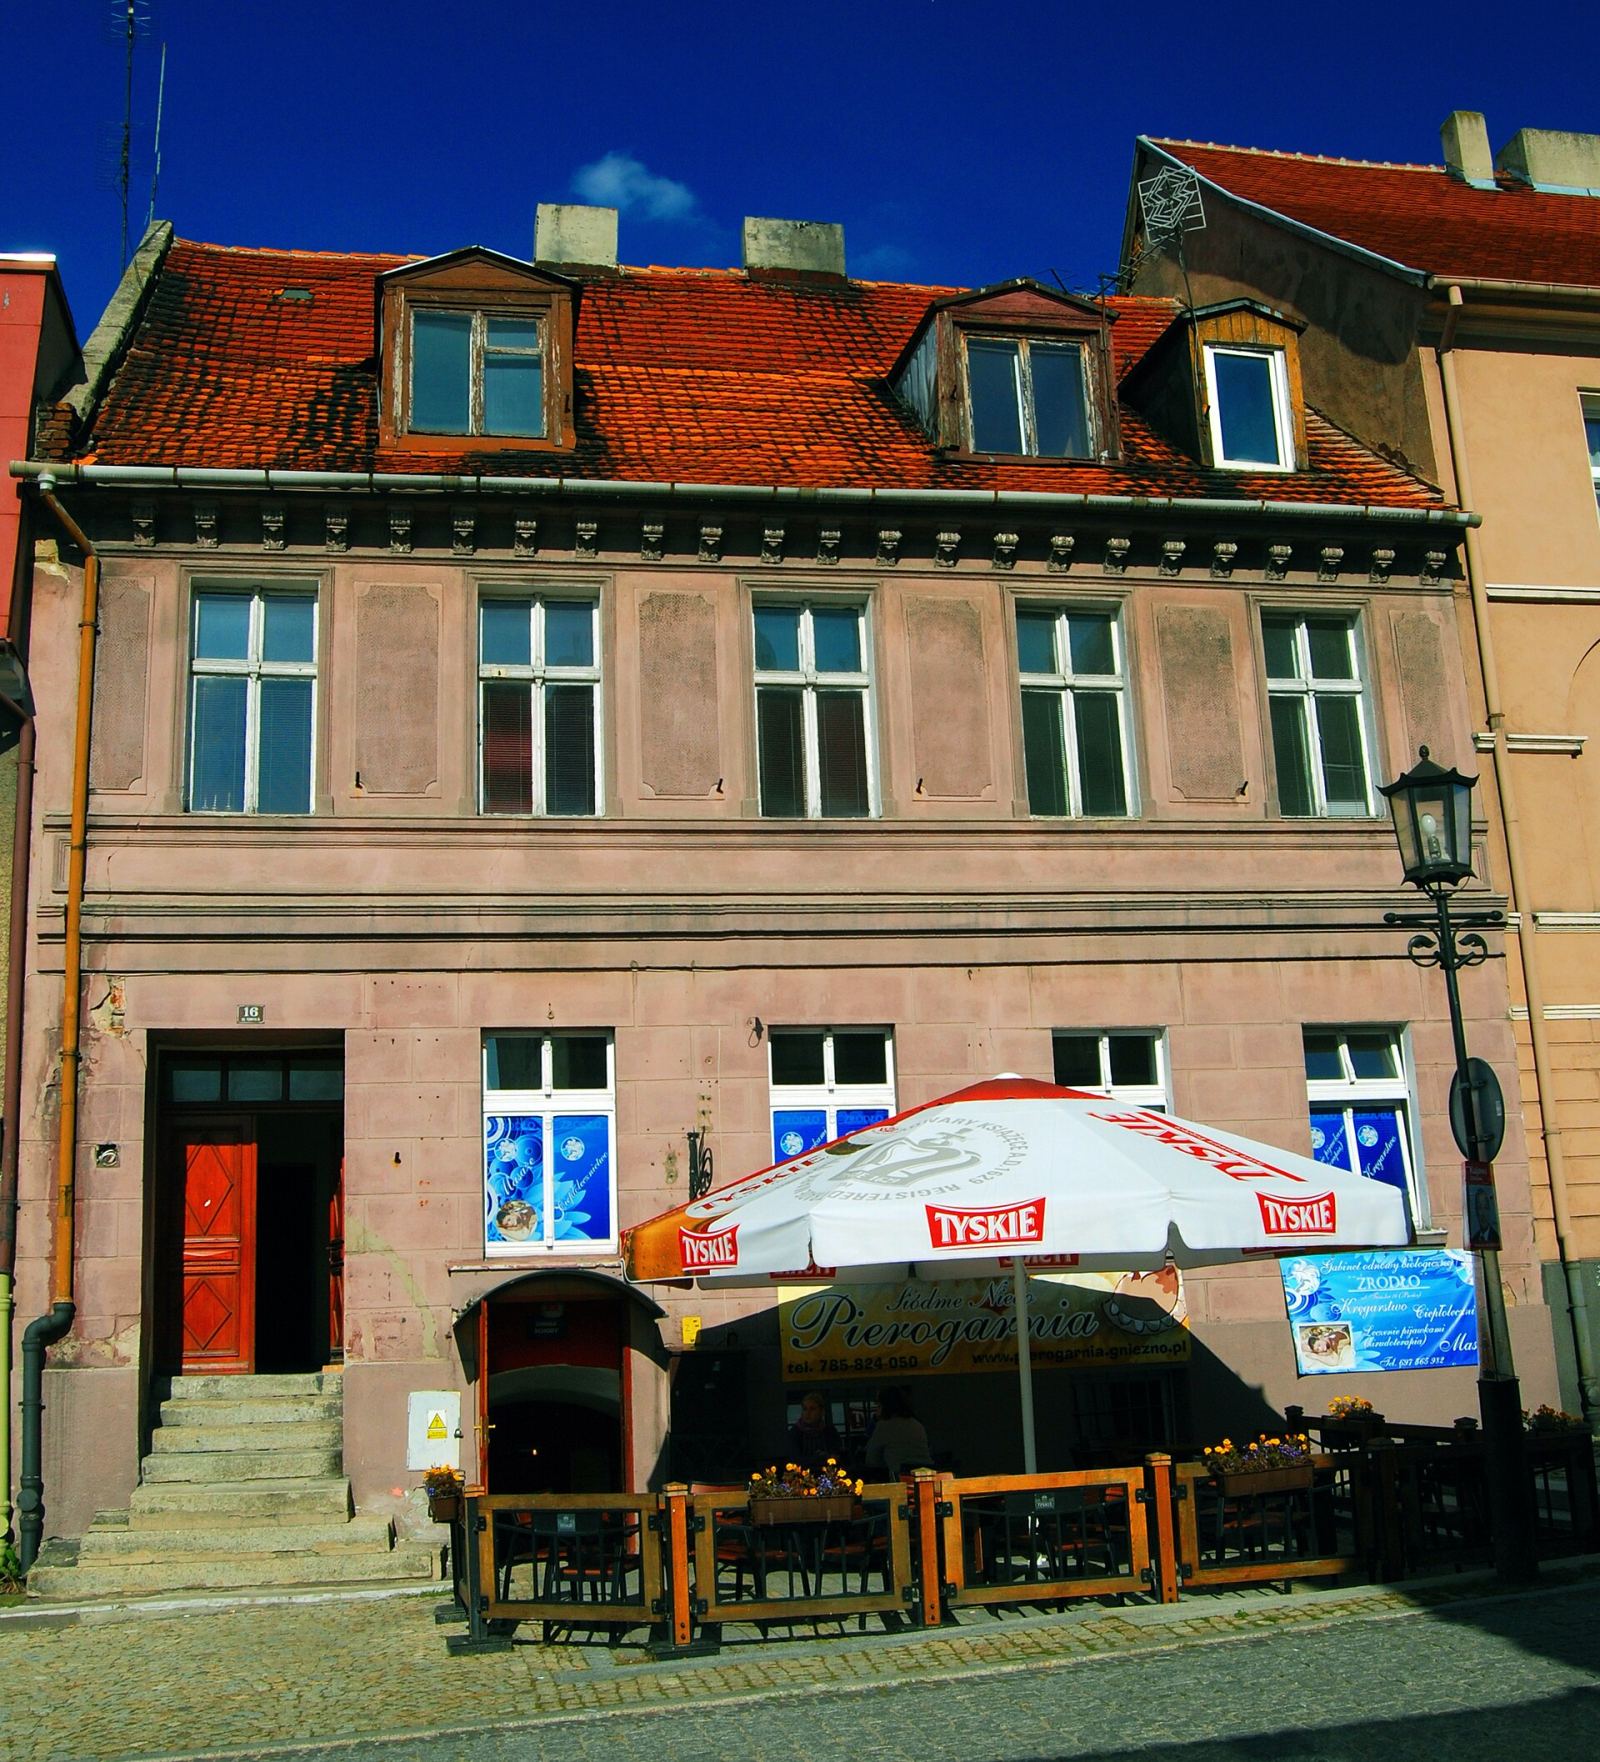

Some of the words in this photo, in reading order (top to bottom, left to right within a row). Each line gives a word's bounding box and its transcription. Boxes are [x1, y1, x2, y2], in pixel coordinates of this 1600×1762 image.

[243, 1006, 259, 1017] 16
[934, 1205, 1039, 1244] TYSKIE
[1263, 1199, 1334, 1231] TYSKIE
[681, 1232, 737, 1265] TYSKIE
[1320, 1260, 1360, 1275] Gabinet
[968, 1281, 1037, 1308] Nieo
[791, 1294, 1098, 1366] Pierogarnia
[788, 1361, 814, 1374] tel.
[819, 1354, 919, 1372] 785-824-050
